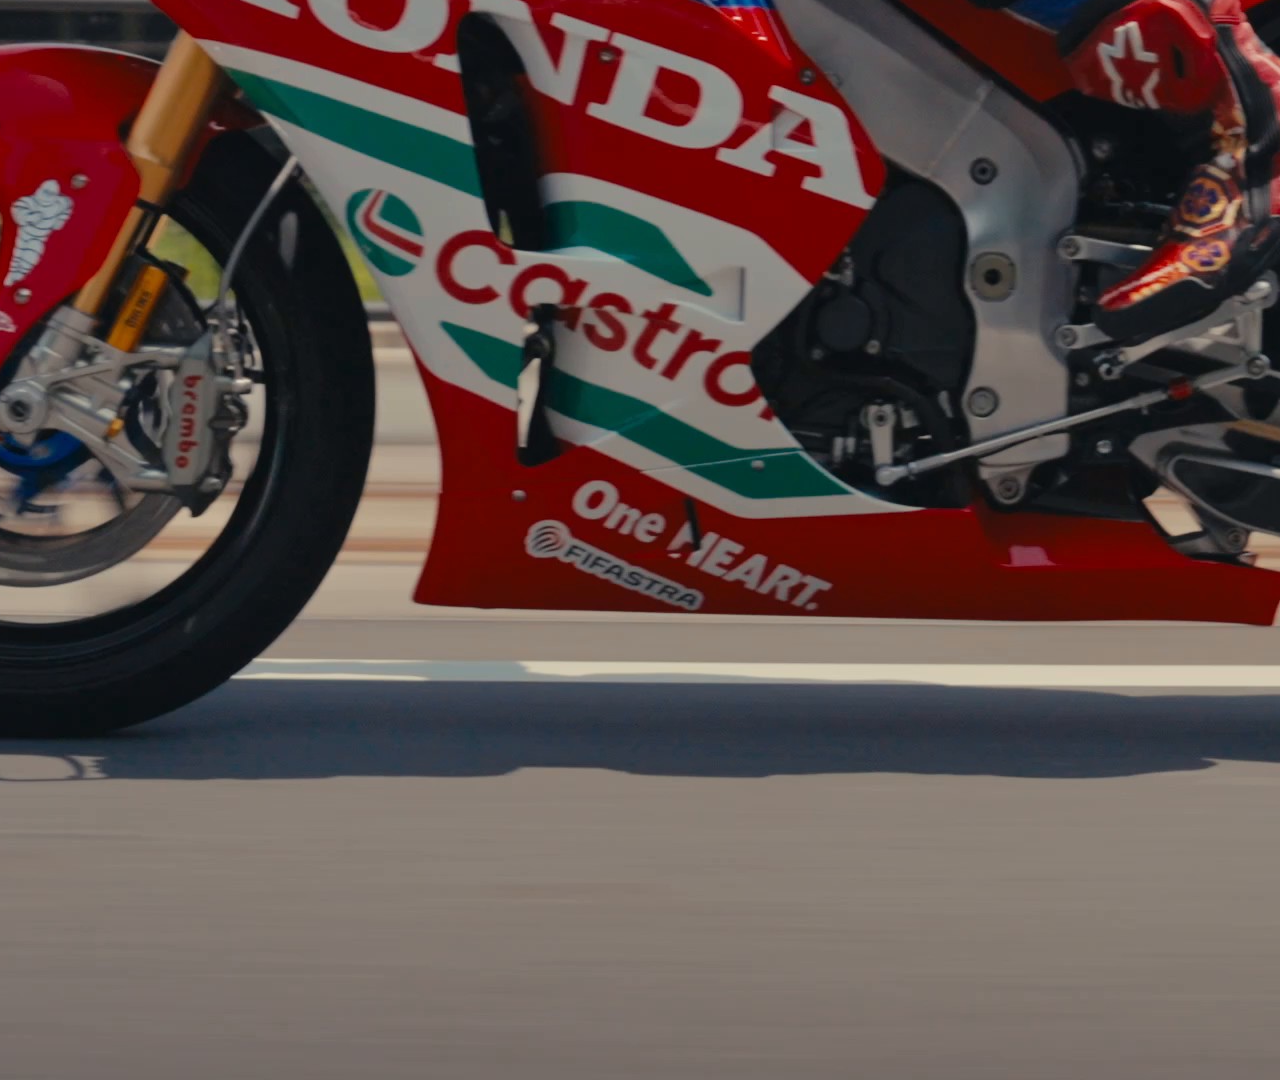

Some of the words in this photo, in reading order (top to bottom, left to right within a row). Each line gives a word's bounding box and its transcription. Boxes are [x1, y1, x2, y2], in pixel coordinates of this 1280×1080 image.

[434, 229, 776, 422] Castro
[175, 374, 204, 469] brembo
[562, 544, 698, 609] FIFASTRA
[572, 480, 666, 543] One
[666, 522, 833, 610] HEART.
